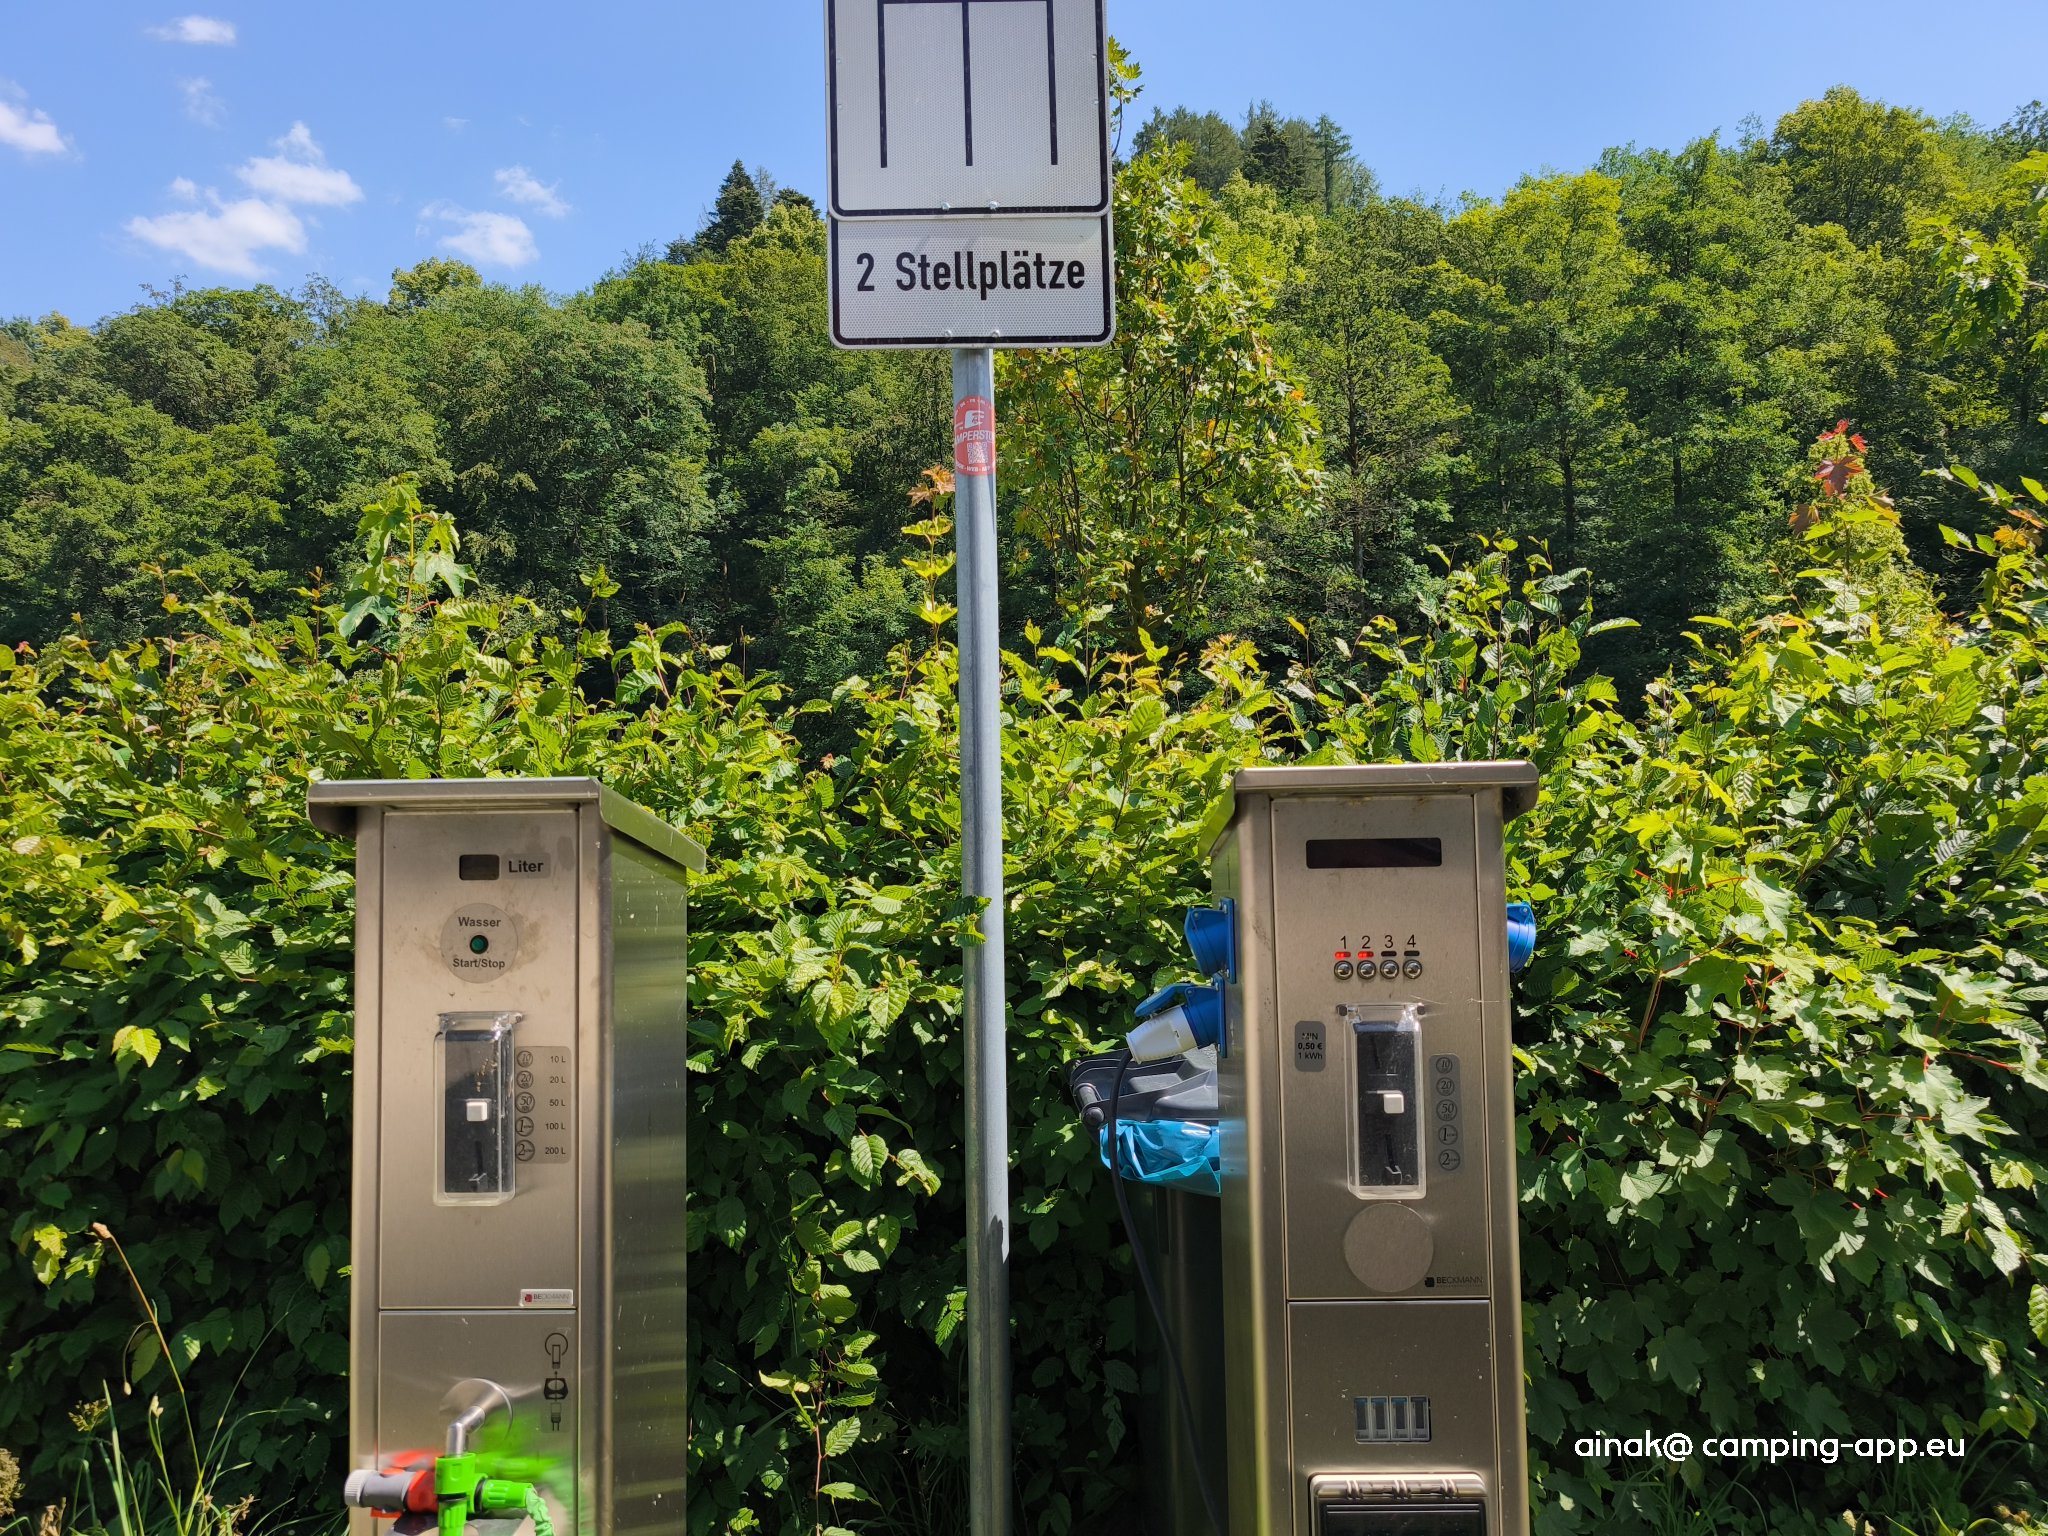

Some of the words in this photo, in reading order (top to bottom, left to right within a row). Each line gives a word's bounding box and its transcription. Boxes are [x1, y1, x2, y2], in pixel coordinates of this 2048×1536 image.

[857, 253, 875, 291] 2
[896, 251, 1085, 300] Stellplätze
[508, 860, 544, 873] Liter
[458, 917, 501, 927] Wasser
[1340, 936, 1347, 949] 1
[1361, 936, 1371, 949] 2
[1384, 935, 1394, 948] 3
[1407, 934, 1417, 948] 4
[452, 958, 505, 970] Start/Stop
[1317, 1042, 1323, 1050] €
[1441, 1081, 1452, 1089] 20
[520, 1096, 532, 1106] 50
[549, 1099, 559, 1107] 50
[561, 1099, 566, 1107] L
[1442, 1104, 1454, 1113] 50
[517, 1120, 524, 1132] 1
[518, 1144, 526, 1155] 2
[1442, 1153, 1450, 1165] 2
